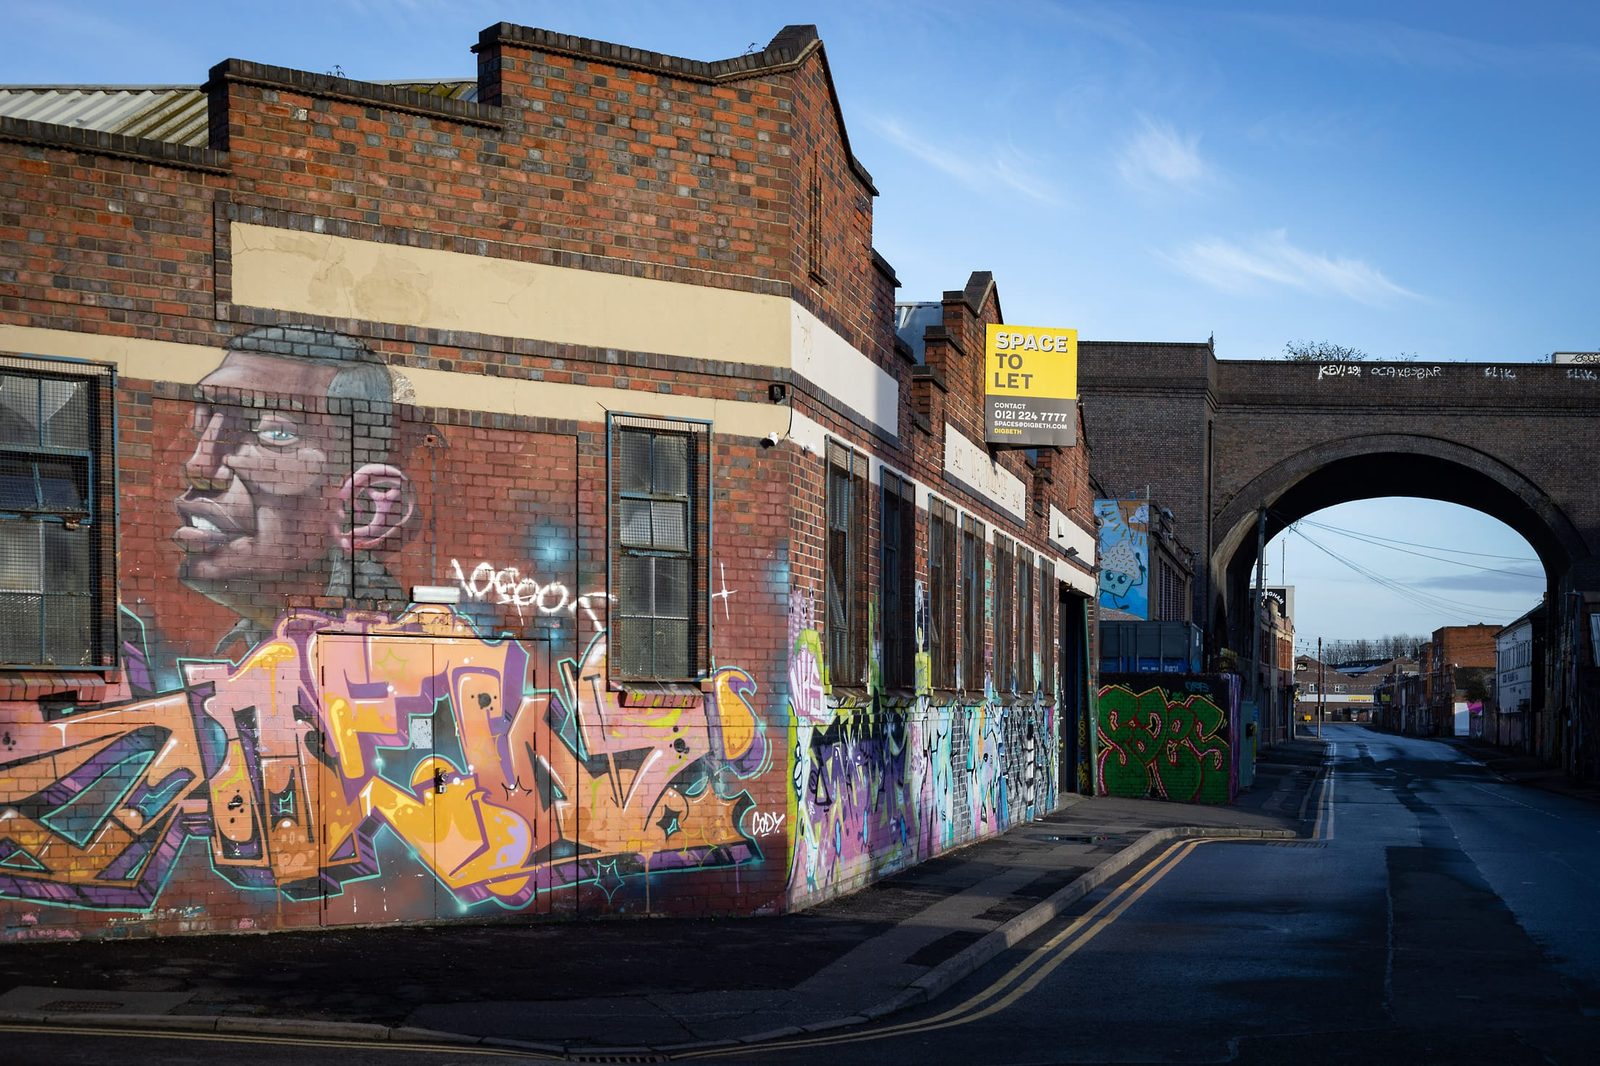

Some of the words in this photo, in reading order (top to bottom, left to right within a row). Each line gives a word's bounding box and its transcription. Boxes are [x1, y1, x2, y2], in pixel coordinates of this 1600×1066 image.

[995, 332, 1068, 353] SPACE
[995, 353, 1023, 369] TO
[995, 372, 1033, 389] LET
[994, 402, 1026, 410] CONTACT
[994, 410, 1015, 419] 0121
[1018, 411, 1038, 421] 224
[1040, 412, 1067, 422] 7777
[994, 420, 1068, 430] SPACES@DIGBETH.COM
